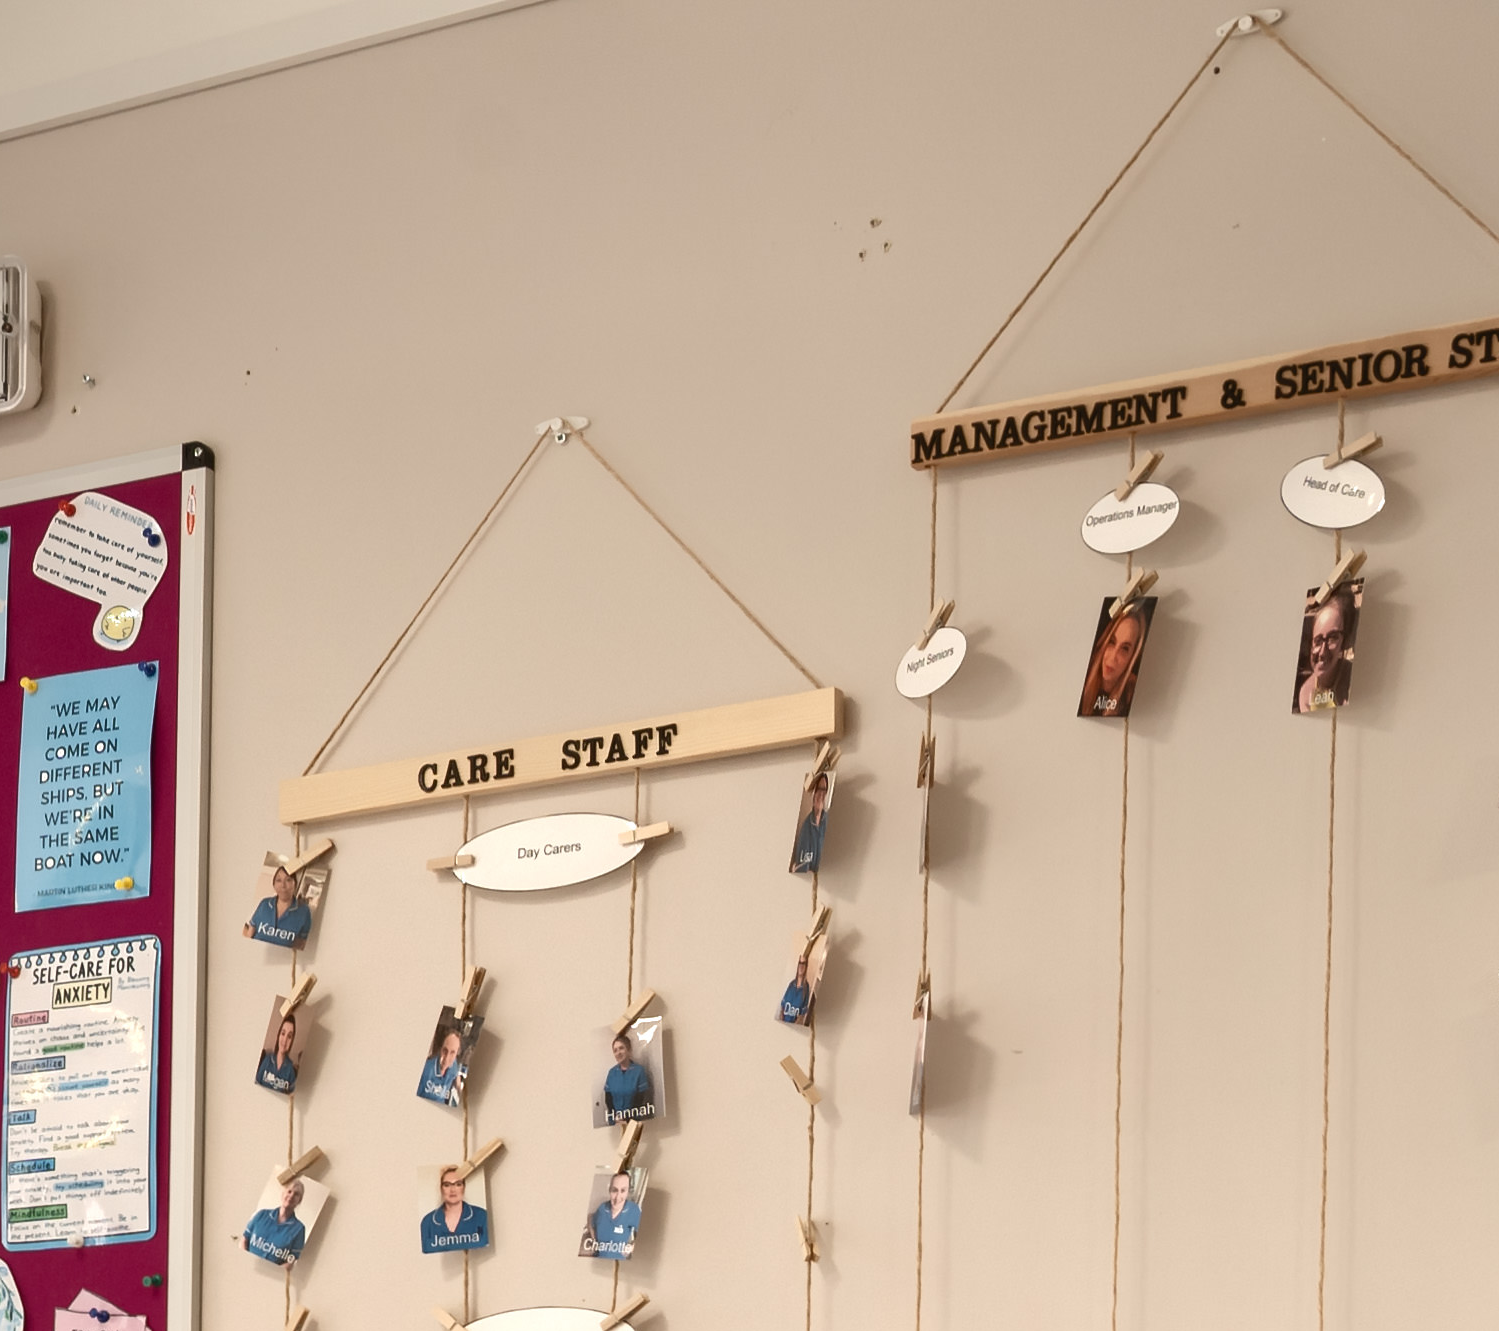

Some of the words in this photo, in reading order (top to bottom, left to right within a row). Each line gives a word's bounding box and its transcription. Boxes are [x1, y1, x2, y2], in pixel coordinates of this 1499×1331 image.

[911, 386, 1187, 463] MANAGEMENT
[1220, 379, 1246, 409] &
[1275, 344, 1429, 400] SENIOR
[1303, 476, 1328, 491] Head
[1329, 482, 1339, 493] of
[1341, 484, 1365, 499] Care
[1086, 510, 1134, 527] Operations
[1137, 500, 1177, 515] Manager
[906, 656, 925, 674] Night
[926, 646, 954, 666] Seniors
[51, 701, 80, 718] "WE
[86, 696, 121, 713] MAY
[1094, 695, 1117, 711] Alice
[47, 721, 87, 740] HAVE
[92, 717, 119, 734] ALL
[45, 742, 89, 762] COME
[94, 739, 117, 754] ON
[418, 748, 515, 793] CARE
[561, 723, 677, 771] STAFF
[39, 759, 122, 784] DIFFERENT
[41, 787, 87, 805] SHIPS,
[93, 781, 124, 798] BUT
[45, 807, 92, 826] WE'RE
[99, 805, 114, 820] IN
[40, 832, 69, 849] THE
[74, 826, 119, 844] SAME
[34, 853, 74, 872] BOAT
[80, 847, 129, 867] NOW."
[517, 847, 540, 860] Day
[543, 841, 581, 856] Carers
[800, 850, 814, 863] Lisa
[257, 921, 295, 941] Karen
[33, 960, 102, 985] SELF-CARE
[109, 956, 135, 974] FOR
[54, 982, 110, 1005] ANXIETY
[783, 1001, 800, 1016] Dan
[262, 1070, 290, 1091] Megan
[604, 1102, 655, 1122] Hannah
[249, 1233, 296, 1264] Michelle
[431, 1233, 480, 1248] Jemma
[583, 1238, 633, 1255] Charlotte
